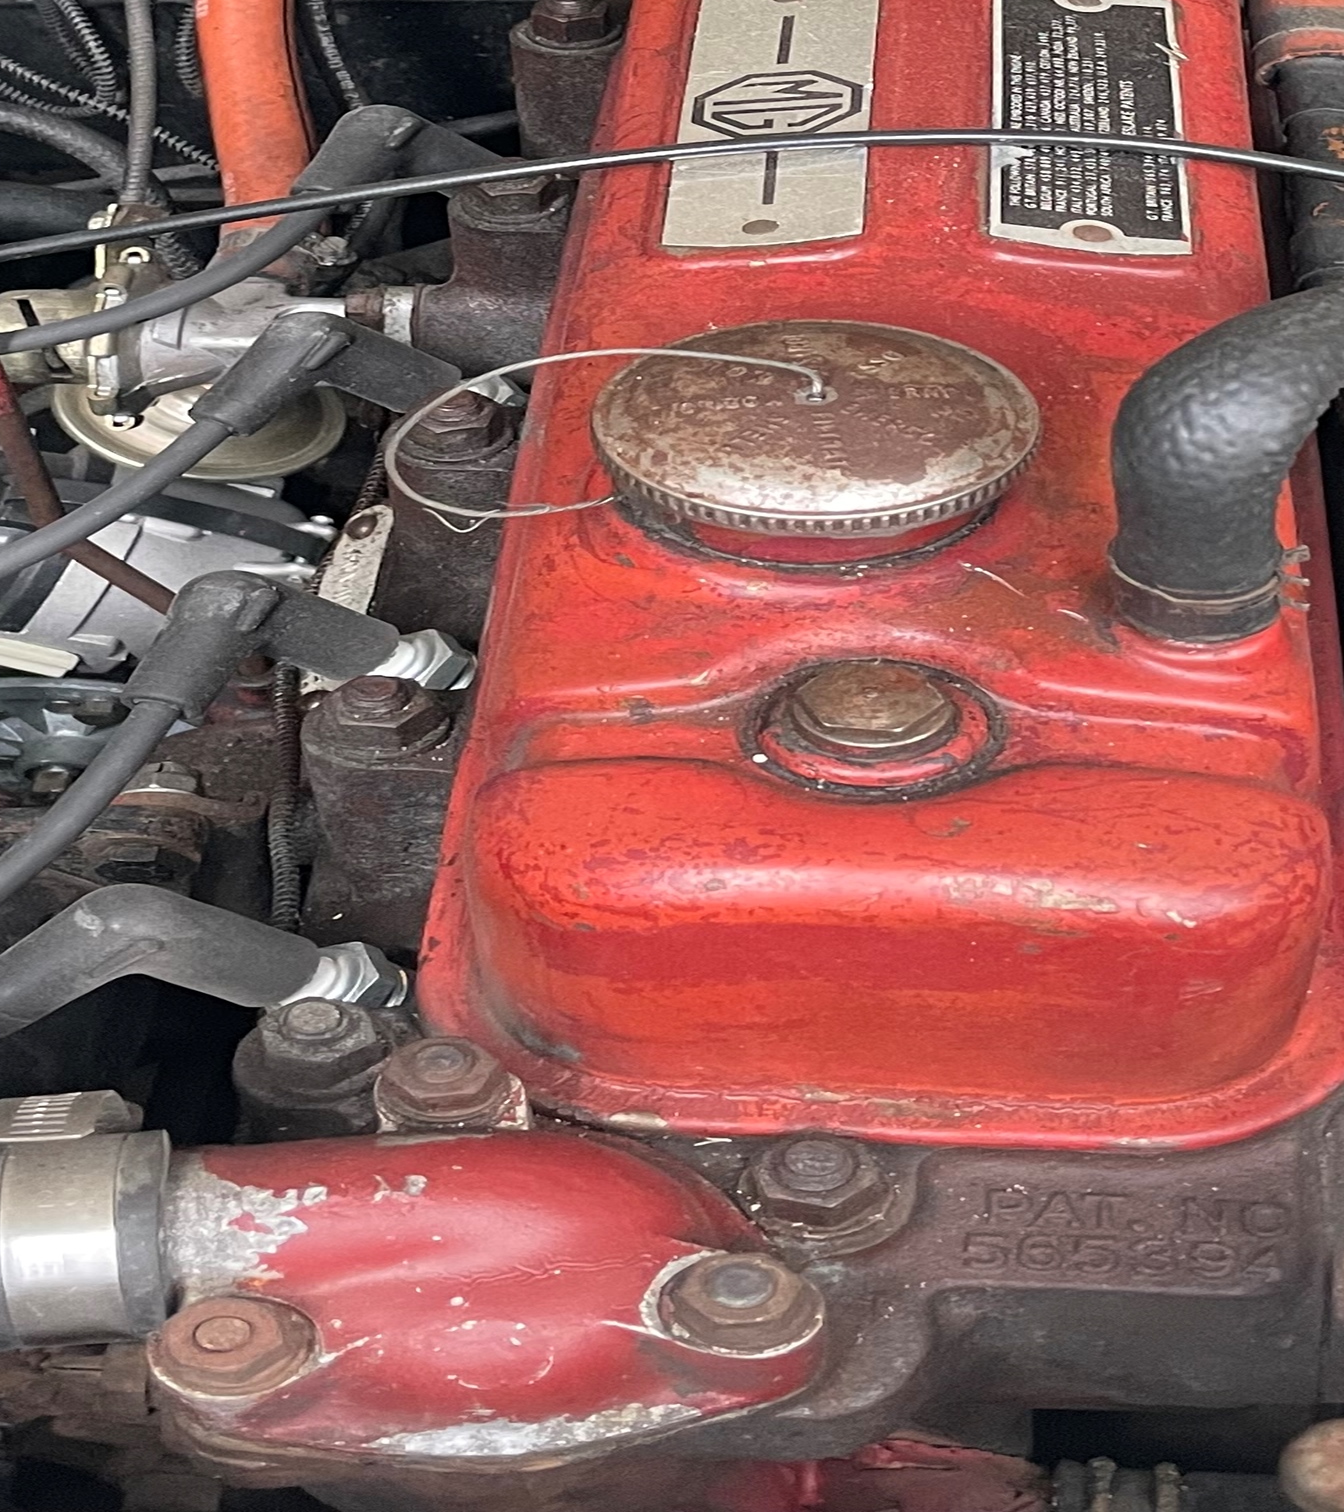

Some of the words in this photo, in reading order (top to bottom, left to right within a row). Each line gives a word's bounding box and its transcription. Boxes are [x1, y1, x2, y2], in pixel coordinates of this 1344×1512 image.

[706, 77, 847, 132] MG
[1119, 80, 1135, 109] PATENTS
[1039, 100, 1051, 124] CANADA
[1120, 111, 1136, 136] ESLAKE
[1009, 161, 1022, 194] FOLLOWIN
[1099, 175, 1112, 195] AFRICA
[1039, 185, 1052, 211] BELGIUM
[1055, 189, 1068, 212] FRANCE
[1070, 197, 1083, 214] ITALY
[1085, 185, 1098, 216] PORTUGAL
[1100, 196, 1113, 217] SOUTH
[1144, 184, 1158, 207] BRITAIN
[1160, 199, 1174, 222] FRANCE
